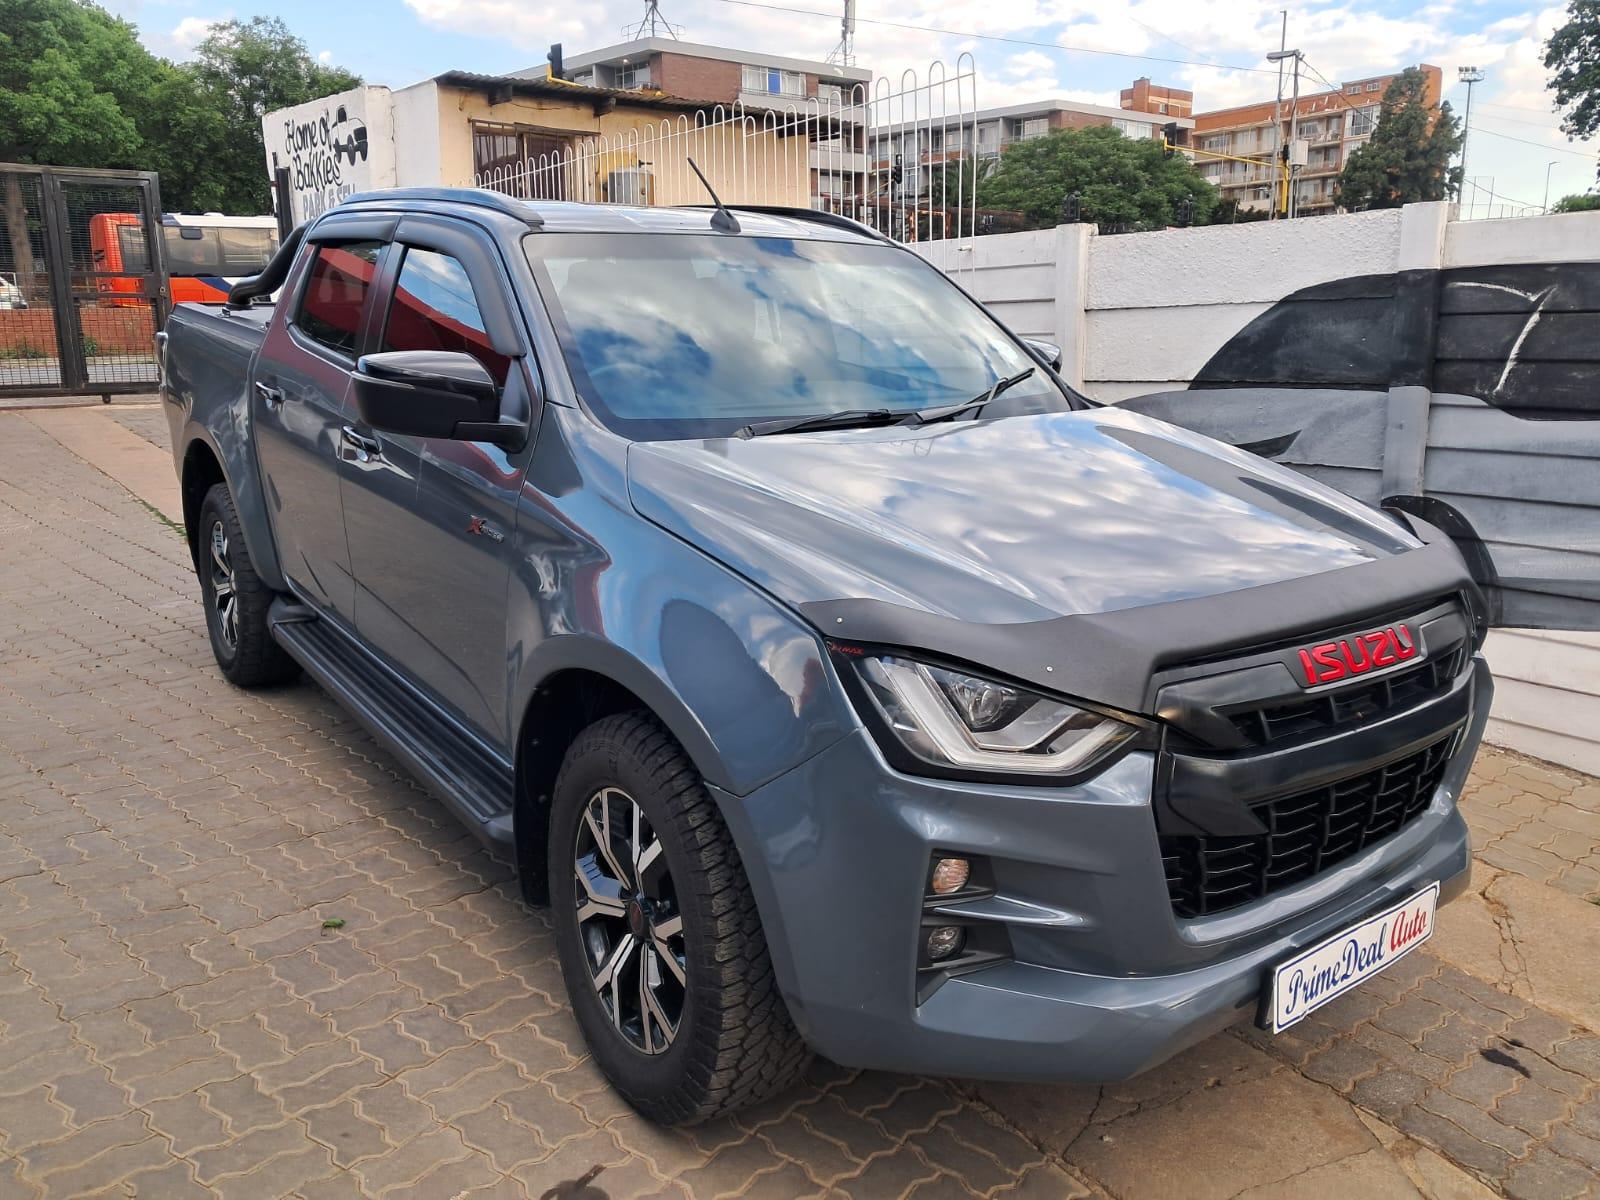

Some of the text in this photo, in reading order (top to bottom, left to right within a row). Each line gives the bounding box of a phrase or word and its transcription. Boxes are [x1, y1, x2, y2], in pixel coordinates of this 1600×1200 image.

[284, 108, 332, 154] Home of
[293, 150, 343, 192] Bakkies
[303, 190, 326, 220] PARK
[1298, 624, 1416, 684] ISUZU
[1285, 907, 1427, 1014] PrimeDeal Auto
